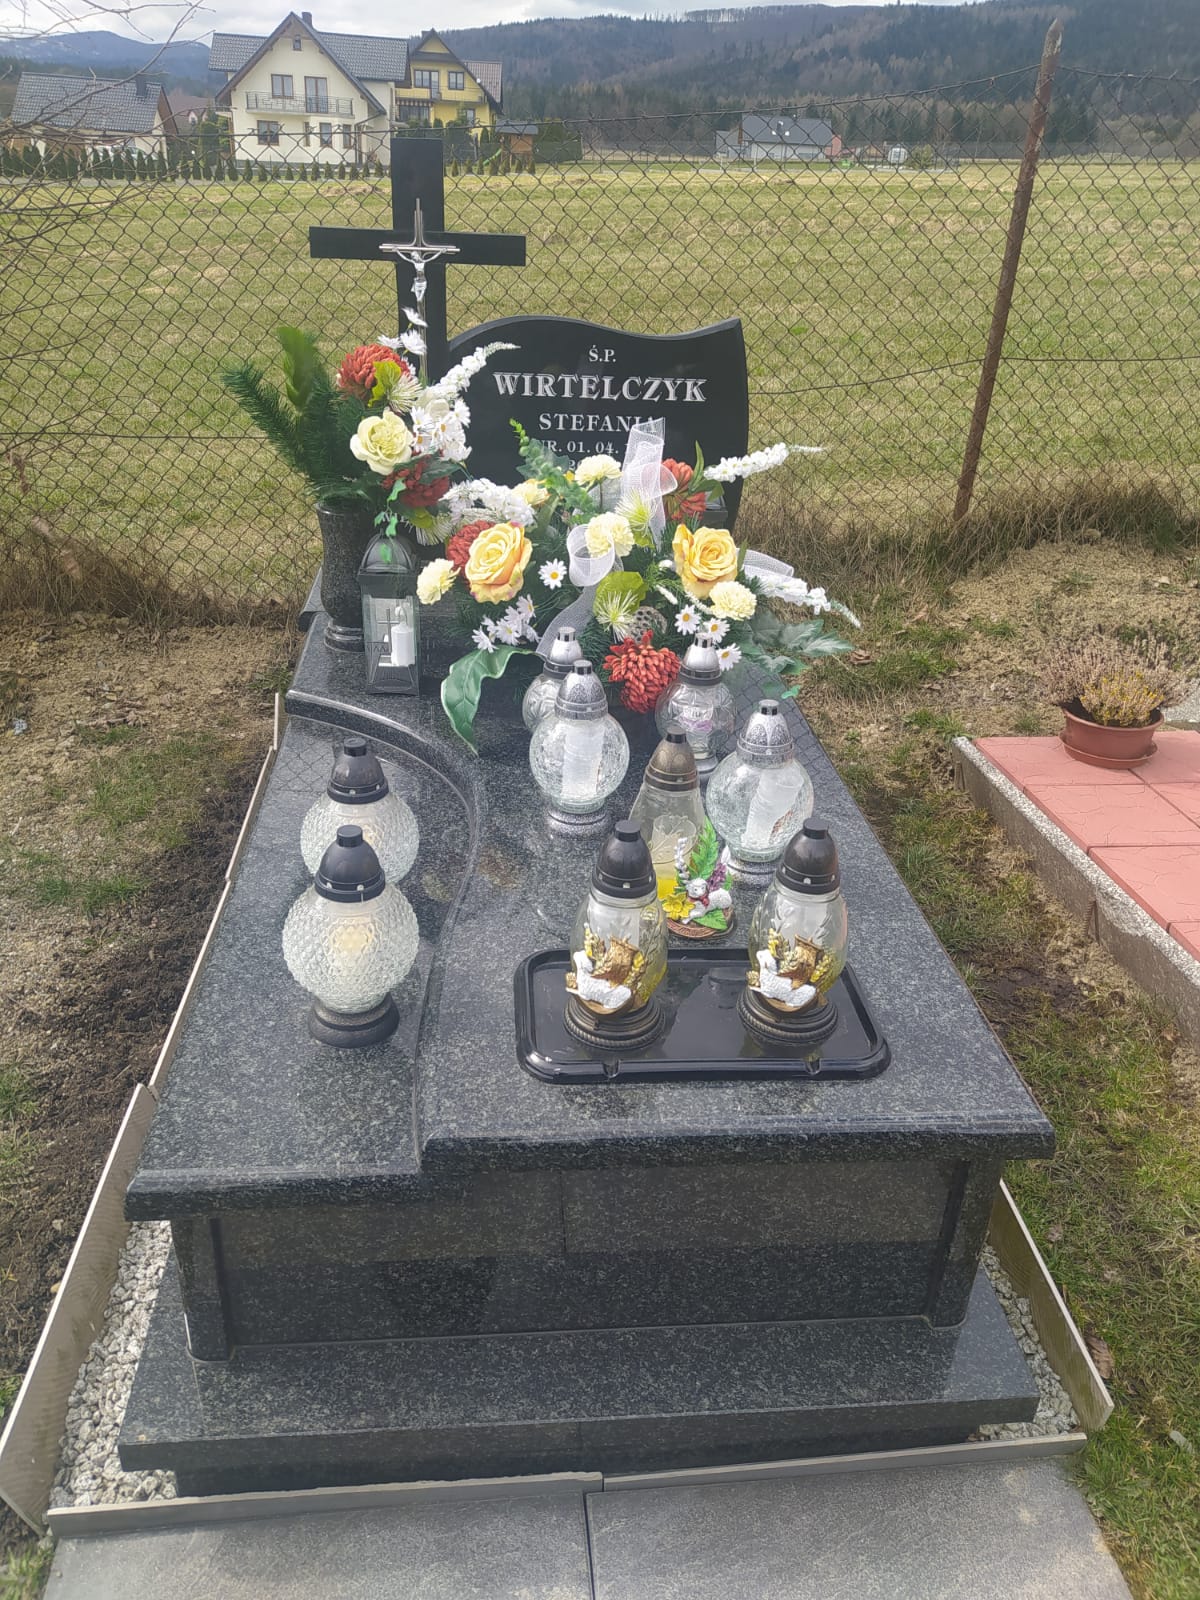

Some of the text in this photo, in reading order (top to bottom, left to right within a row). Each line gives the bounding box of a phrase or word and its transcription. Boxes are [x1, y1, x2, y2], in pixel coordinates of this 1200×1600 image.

[588, 345, 616, 362] Ś.P.
[492, 371, 707, 402] WIRTELCZYK
[567, 440, 591, 453] 01.
